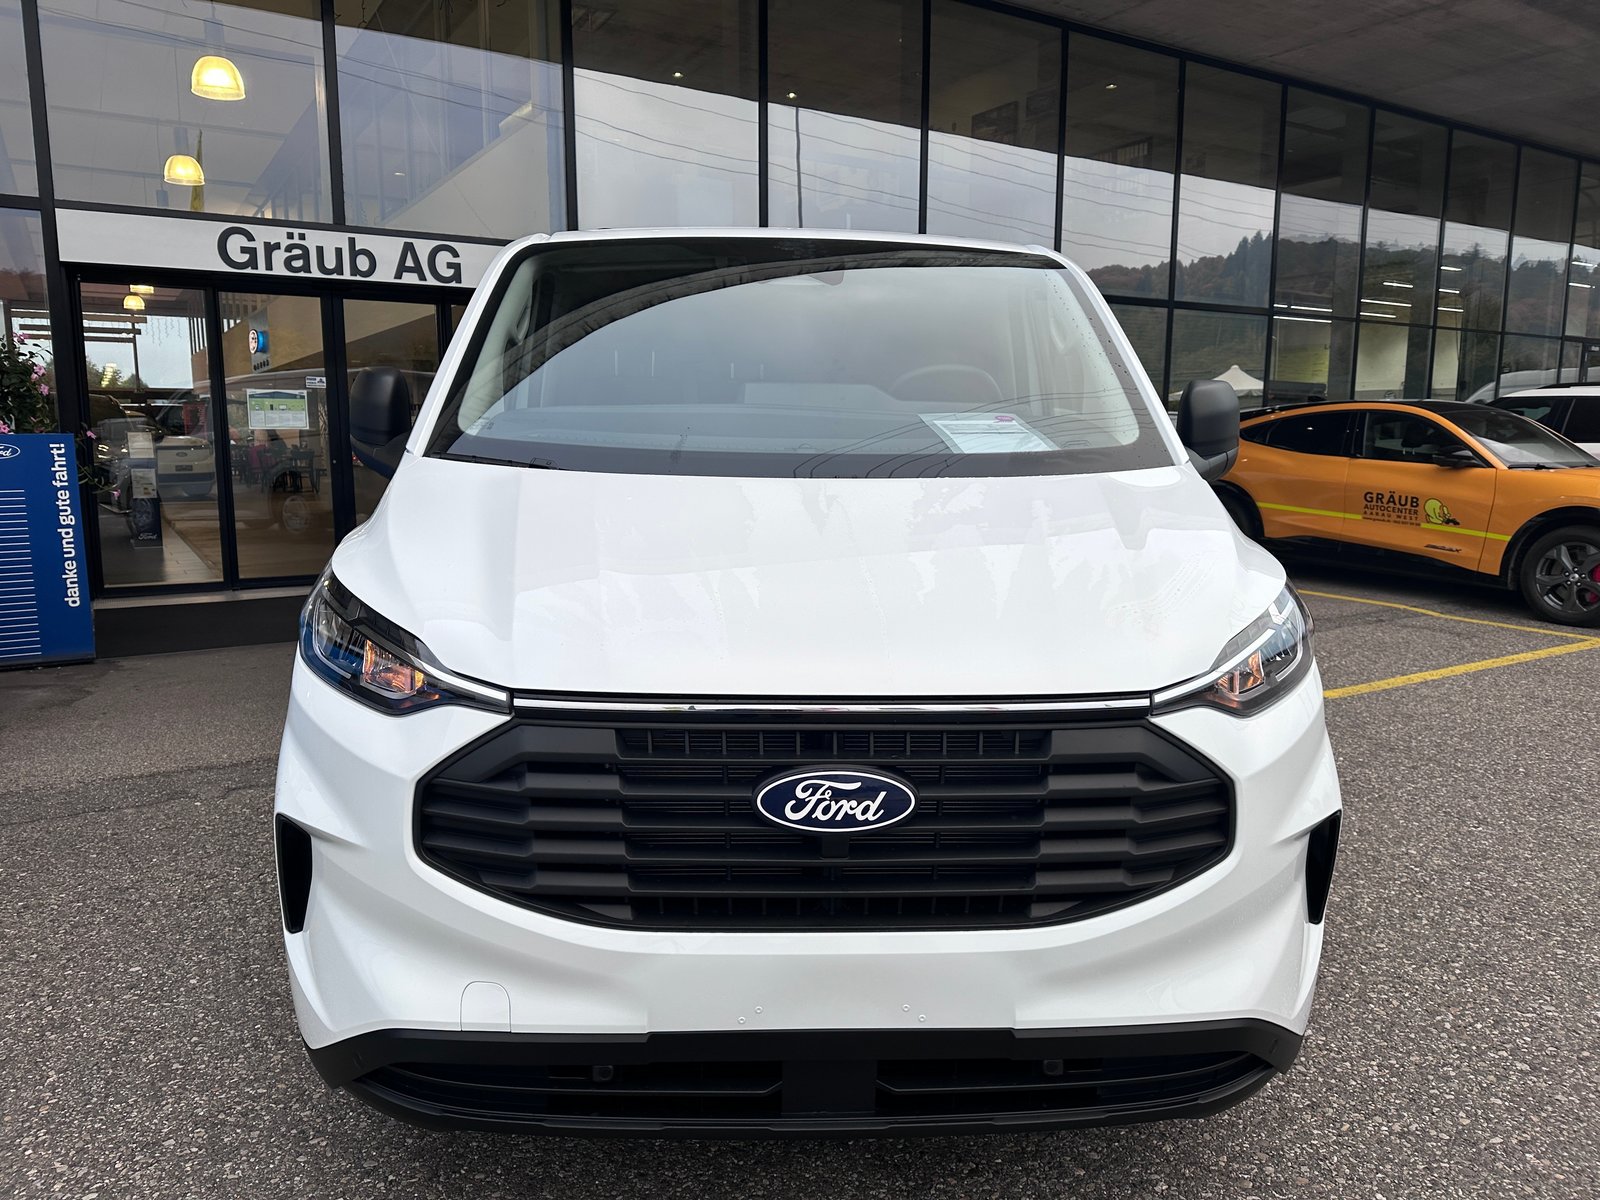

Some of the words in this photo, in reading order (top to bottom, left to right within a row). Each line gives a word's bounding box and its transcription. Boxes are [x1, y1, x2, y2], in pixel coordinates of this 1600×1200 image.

[216, 226, 377, 278] Gräub
[393, 241, 462, 284] AG
[49, 443, 69, 488] fahrt!
[55, 489, 76, 526] gute
[1363, 490, 1419, 508] GRÄUB
[1363, 503, 1419, 516] AUTOCENTER
[57, 528, 76, 558] und
[62, 560, 81, 608] danke
[784, 779, 888, 821] Ford
